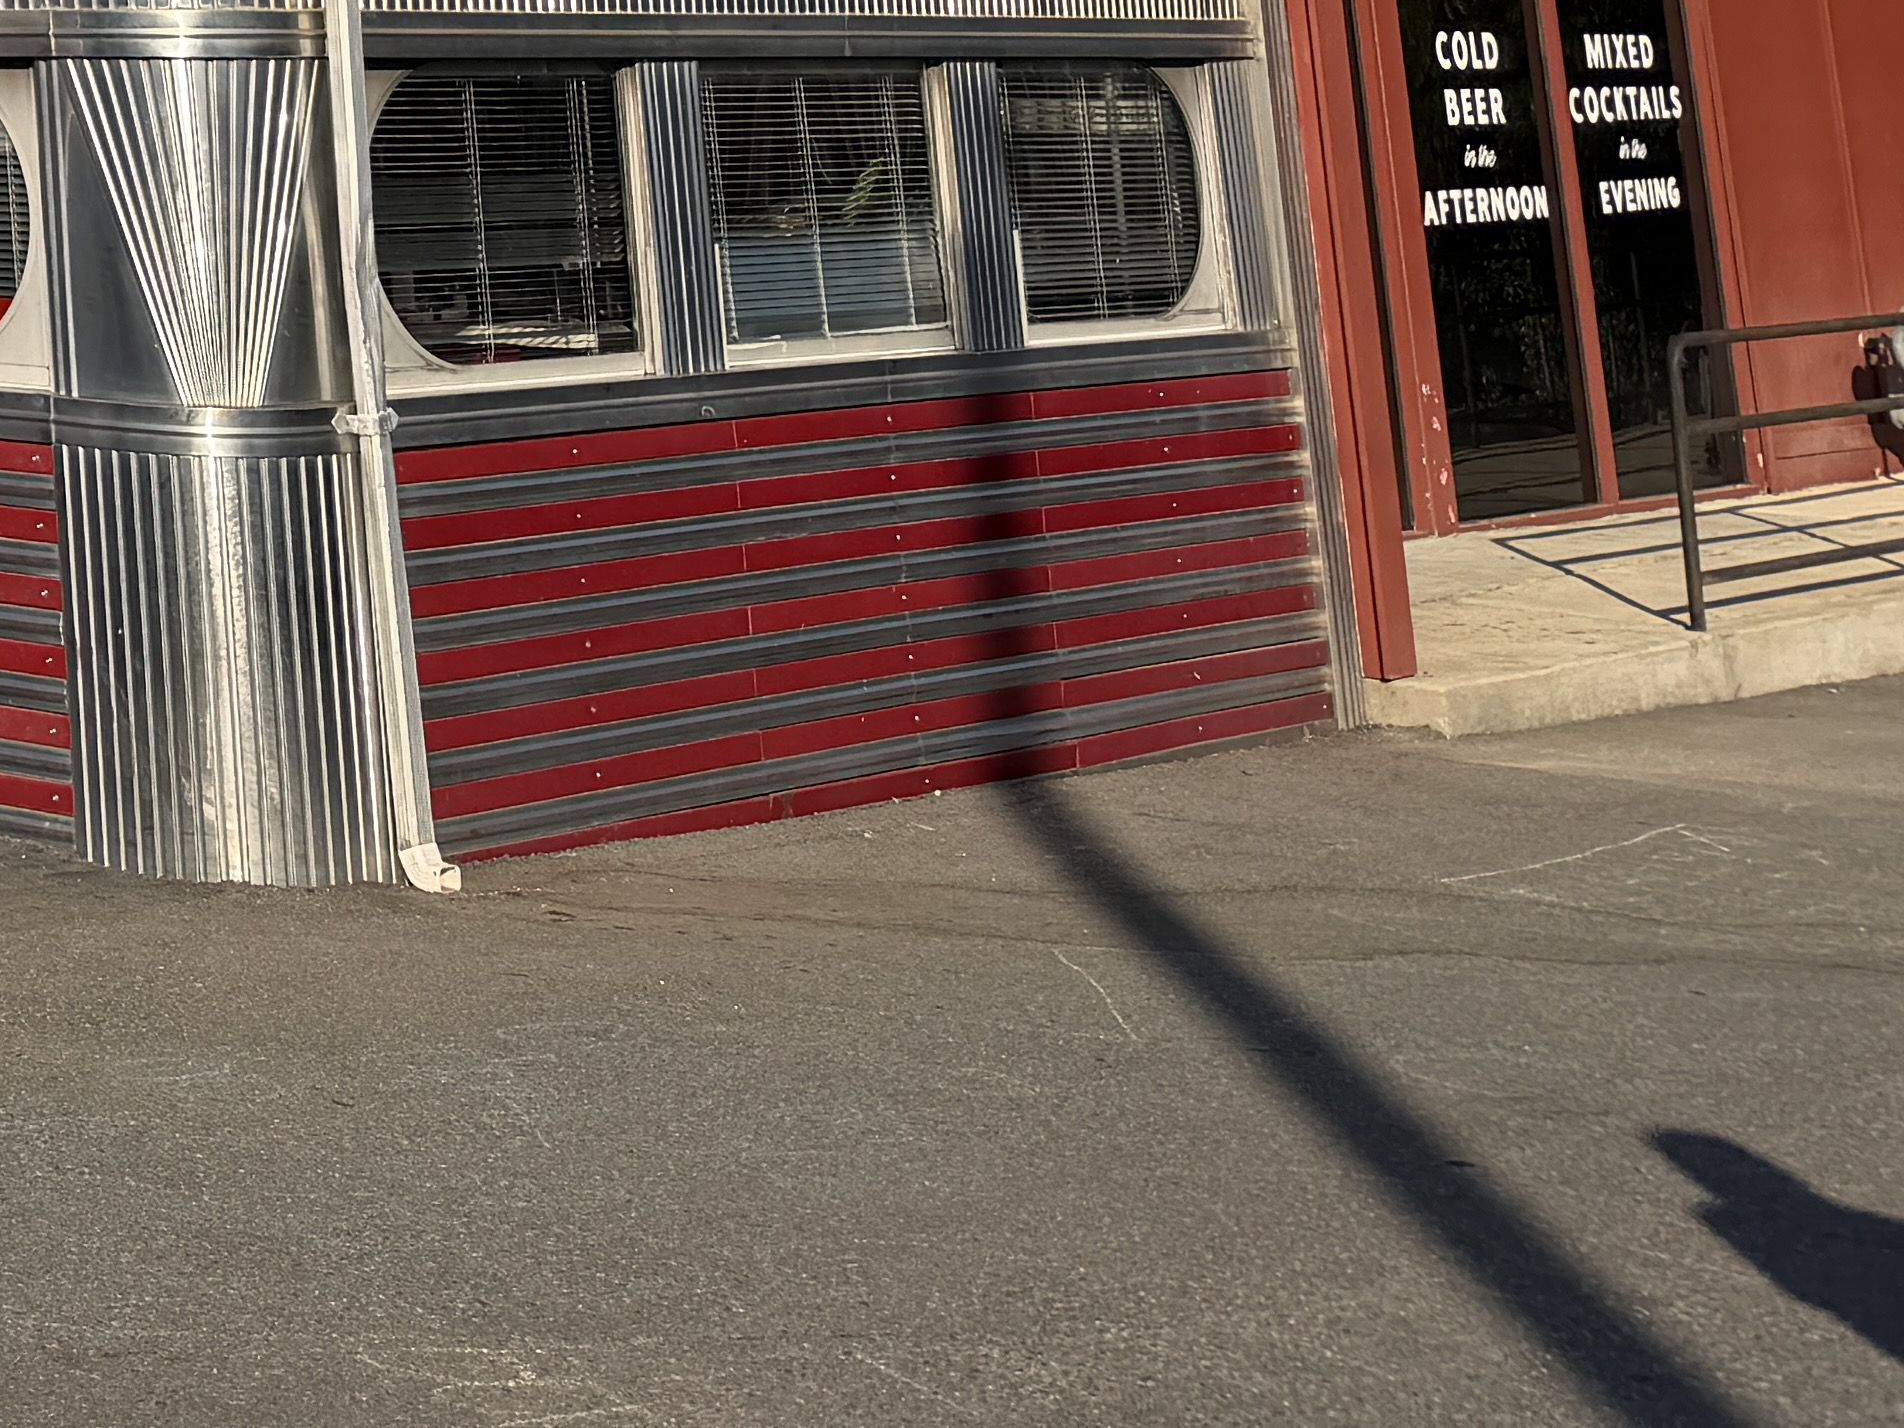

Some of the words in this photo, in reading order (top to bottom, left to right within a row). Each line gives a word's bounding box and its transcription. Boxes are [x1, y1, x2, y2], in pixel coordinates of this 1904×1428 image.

[1435, 30, 1499, 70] COLD
[1583, 33, 1654, 69] MIXED
[1444, 88, 1507, 126] BEER
[1569, 85, 1682, 123] COCKTAILS
[1464, 145, 1477, 169] in
[1619, 136, 1630, 159] in
[1424, 185, 1550, 226] AFTERNOON
[1599, 176, 1681, 214] EVENING
